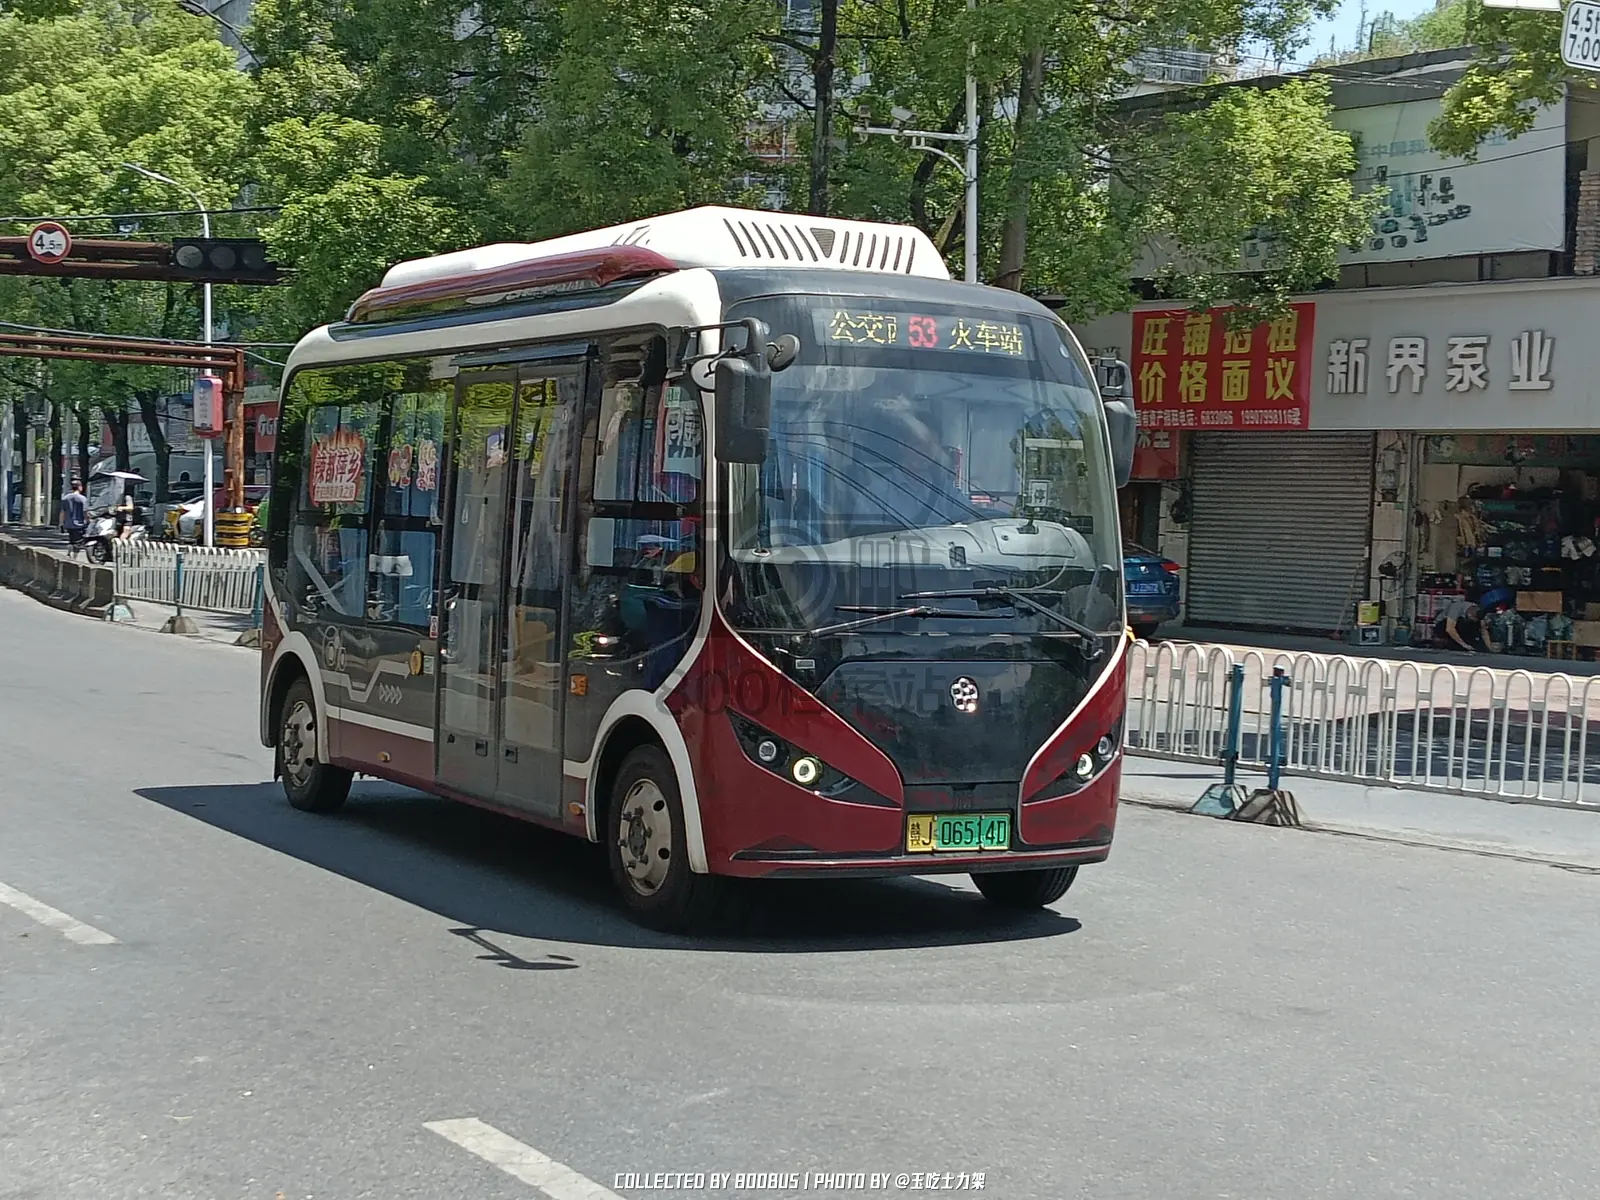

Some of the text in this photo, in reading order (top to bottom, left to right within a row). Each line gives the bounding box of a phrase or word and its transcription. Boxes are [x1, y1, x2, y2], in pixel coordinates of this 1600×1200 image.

[1571, 7, 1600, 35] 4.5t
[908, 316, 938, 349] 53
[948, 318, 1023, 356] 火车站
[1138, 357, 1297, 404] 价格面议
[1327, 331, 1553, 395] 新界泵业
